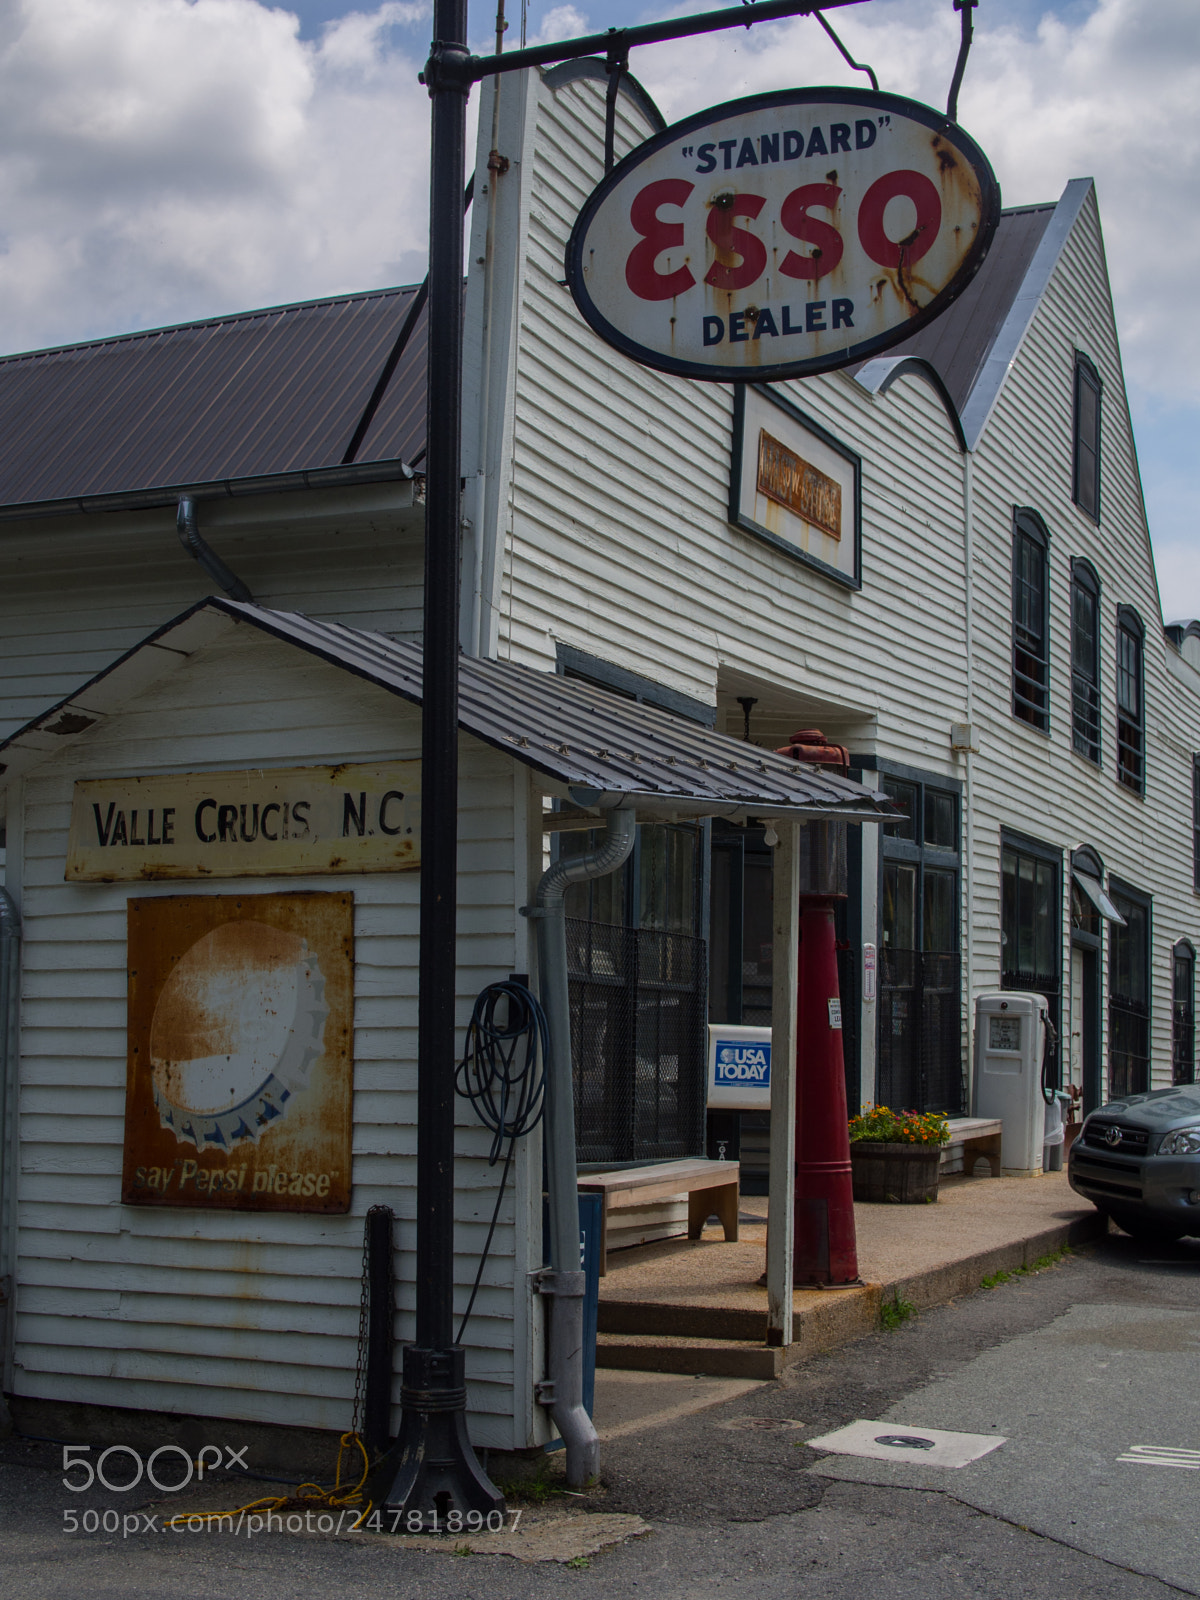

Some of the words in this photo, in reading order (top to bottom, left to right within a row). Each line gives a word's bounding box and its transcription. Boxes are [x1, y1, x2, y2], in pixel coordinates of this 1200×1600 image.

[625, 169, 942, 301] ESSO
[702, 297, 855, 347] DEALER
[92, 802, 176, 847] VALLE
[717, 1063, 768, 1081] TODAY
[734, 1048, 767, 1065] USA
[133, 1166, 175, 1196] say
